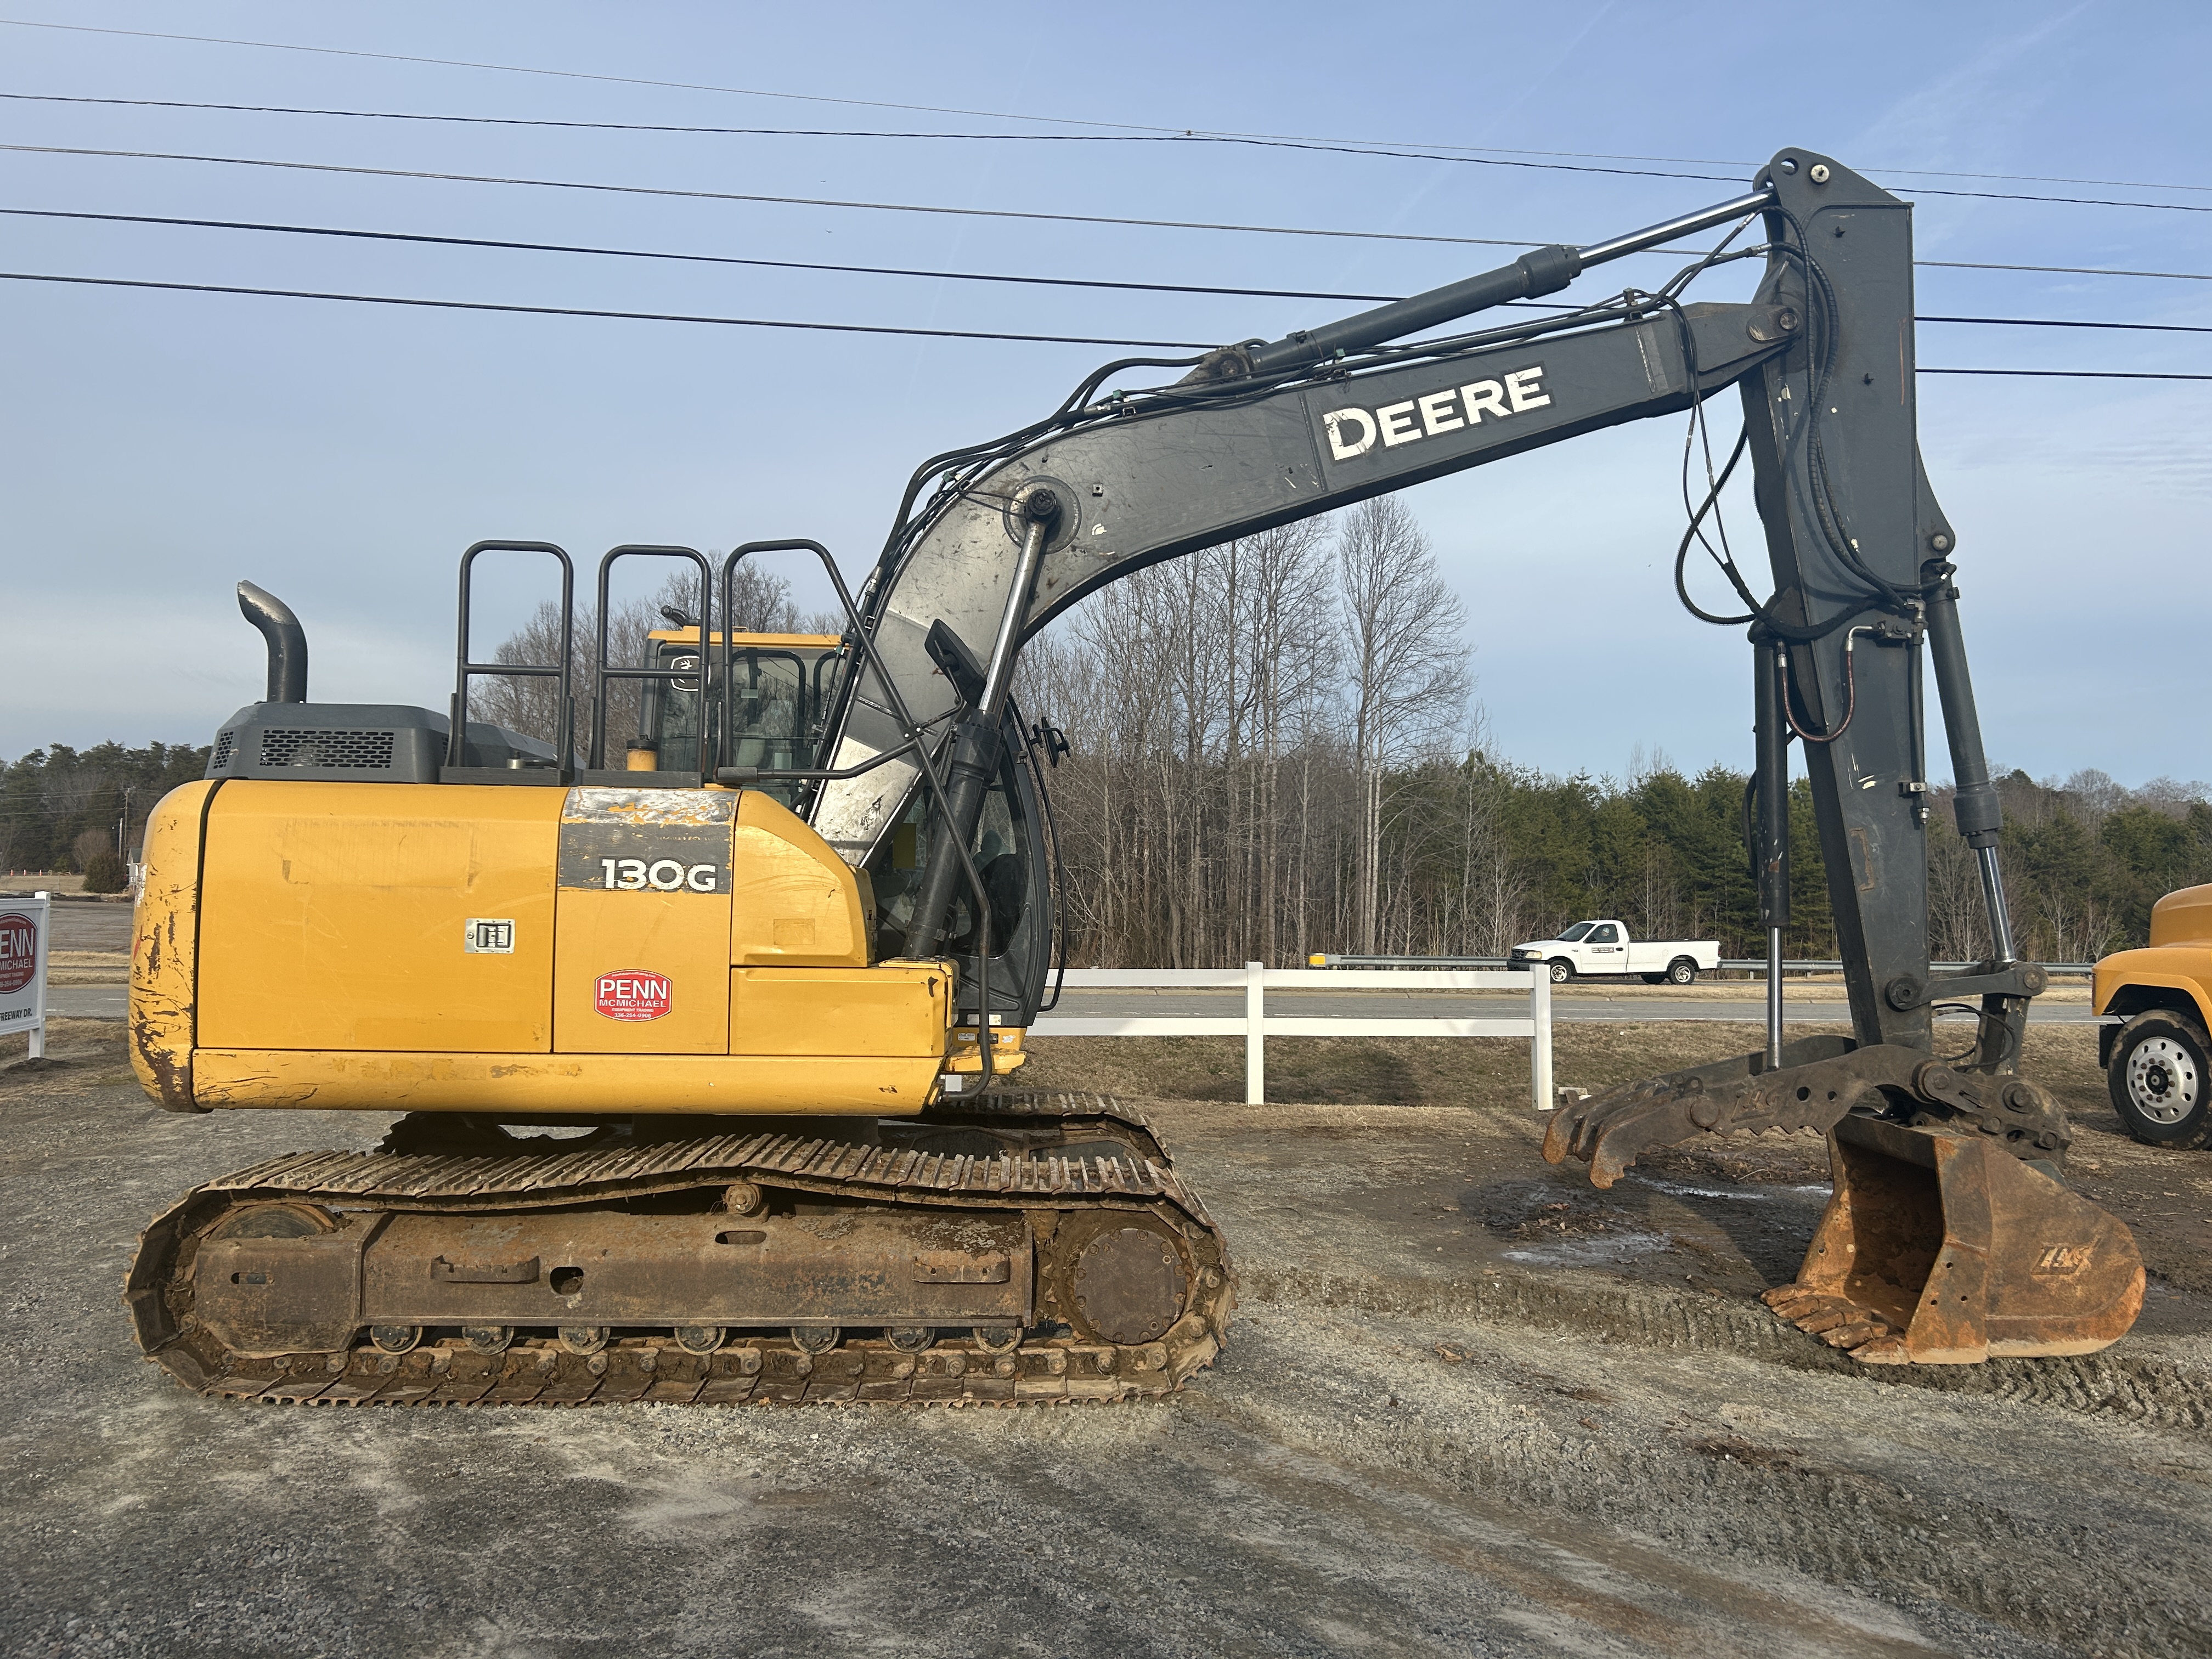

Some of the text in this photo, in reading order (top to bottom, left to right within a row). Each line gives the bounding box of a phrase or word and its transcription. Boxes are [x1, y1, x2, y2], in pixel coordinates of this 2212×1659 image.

[1323, 366, 1551, 461] DEERE
[602, 859, 716, 891] 130G
[0, 928, 34, 958] ENN
[0, 958, 33, 970] MICHAEL
[600, 979, 667, 999] PENN
[23, 1008, 33, 1018] DR.
[599, 999, 667, 1007] MCMICHAEL
